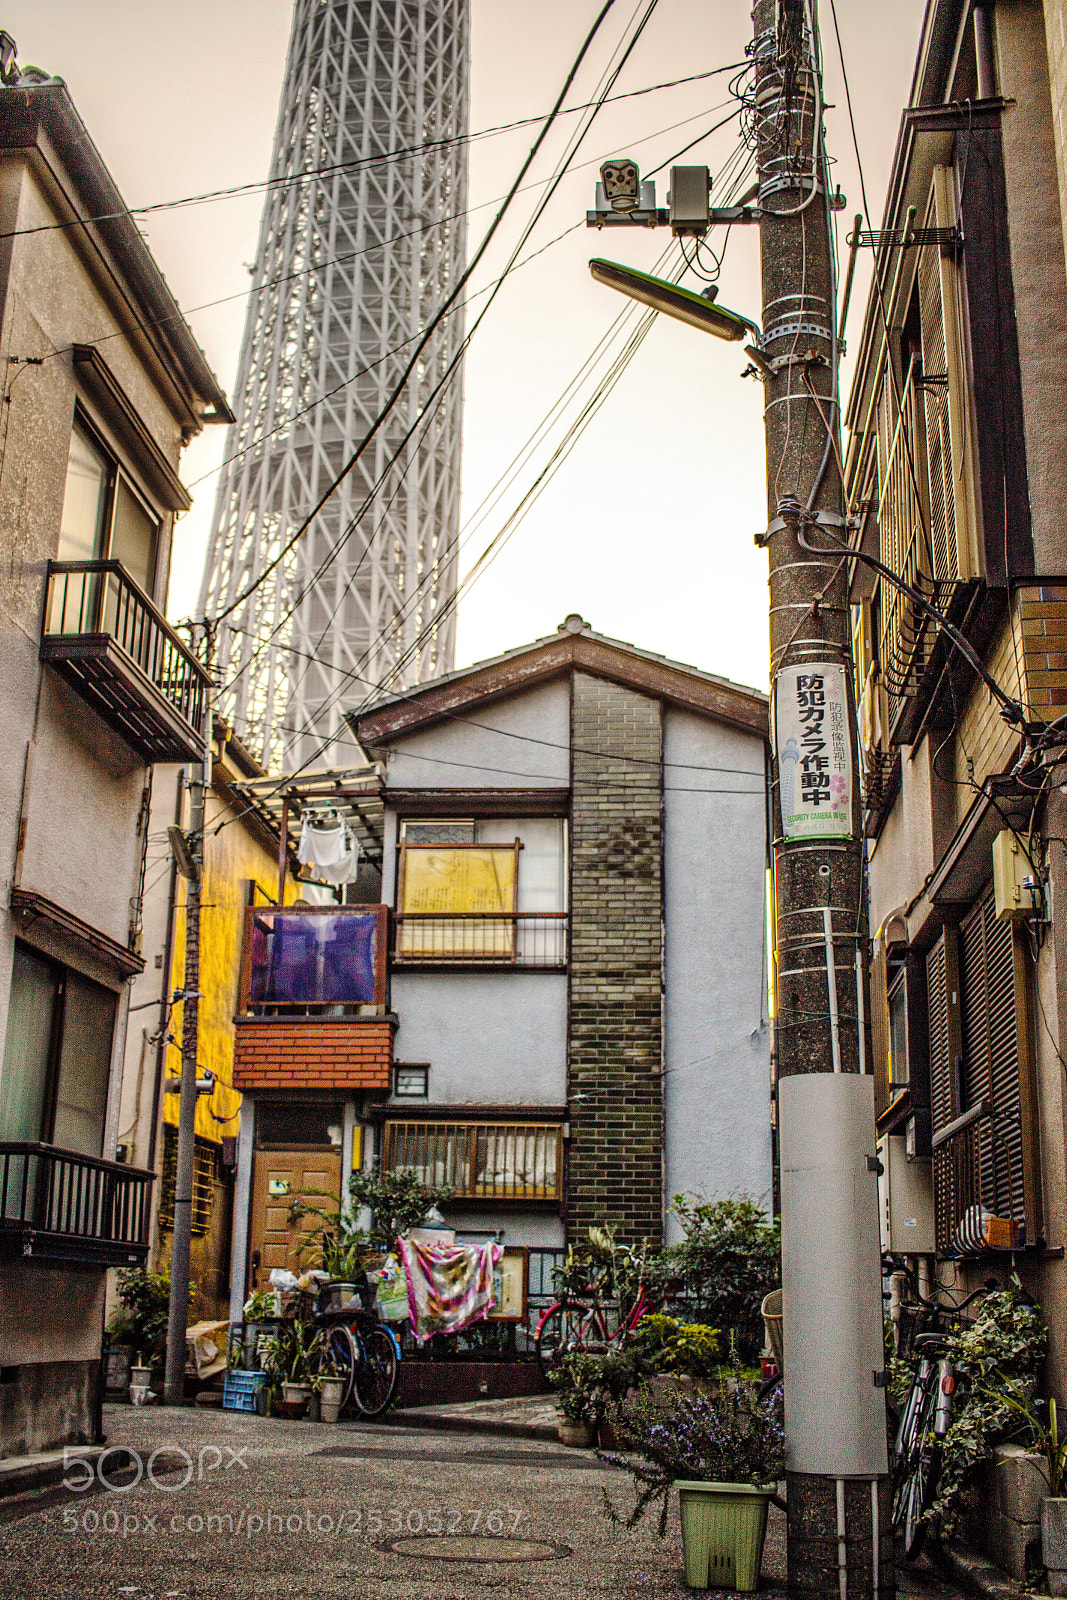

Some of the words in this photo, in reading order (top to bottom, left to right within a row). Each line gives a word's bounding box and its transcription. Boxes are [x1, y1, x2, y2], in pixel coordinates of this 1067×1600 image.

[796, 674, 831, 806] 防犯カメラ作動中
[829, 702, 846, 772] 防犯录像监视中
[787, 813, 809, 823] SECURITY
[810, 811, 832, 820] CAMERA
[838, 812, 847, 821] USE
